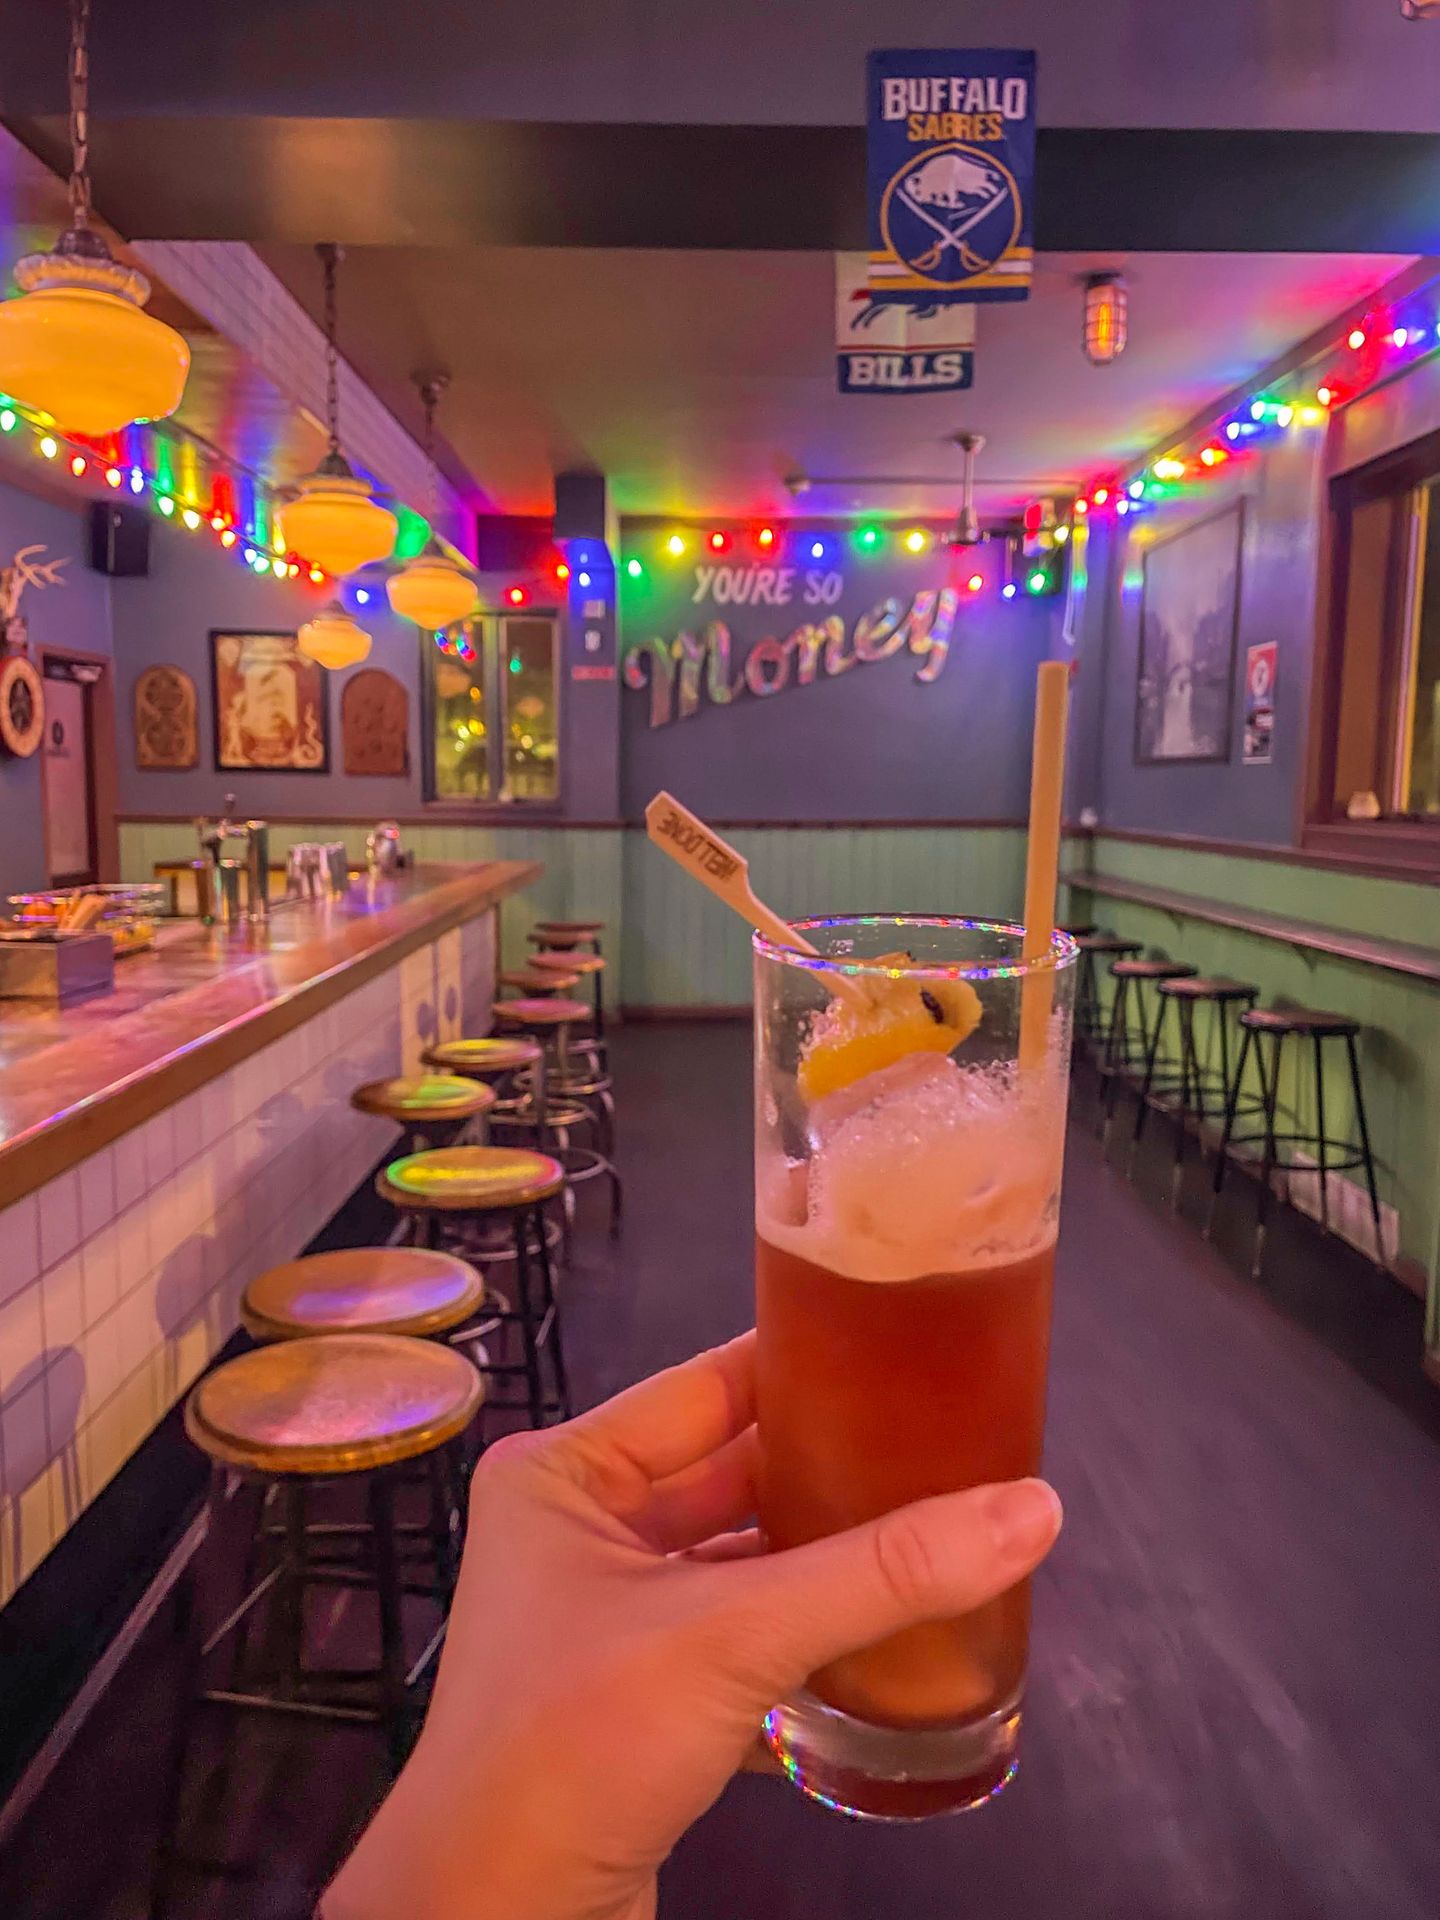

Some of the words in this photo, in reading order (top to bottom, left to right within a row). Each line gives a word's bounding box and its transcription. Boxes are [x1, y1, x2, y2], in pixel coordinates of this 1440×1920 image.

[882, 77, 1027, 120] BUFFALO
[907, 113, 1004, 142] SABRES
[848, 353, 963, 387] BILLS
[803, 568, 844, 605] SO
[625, 588, 957, 728] Money
